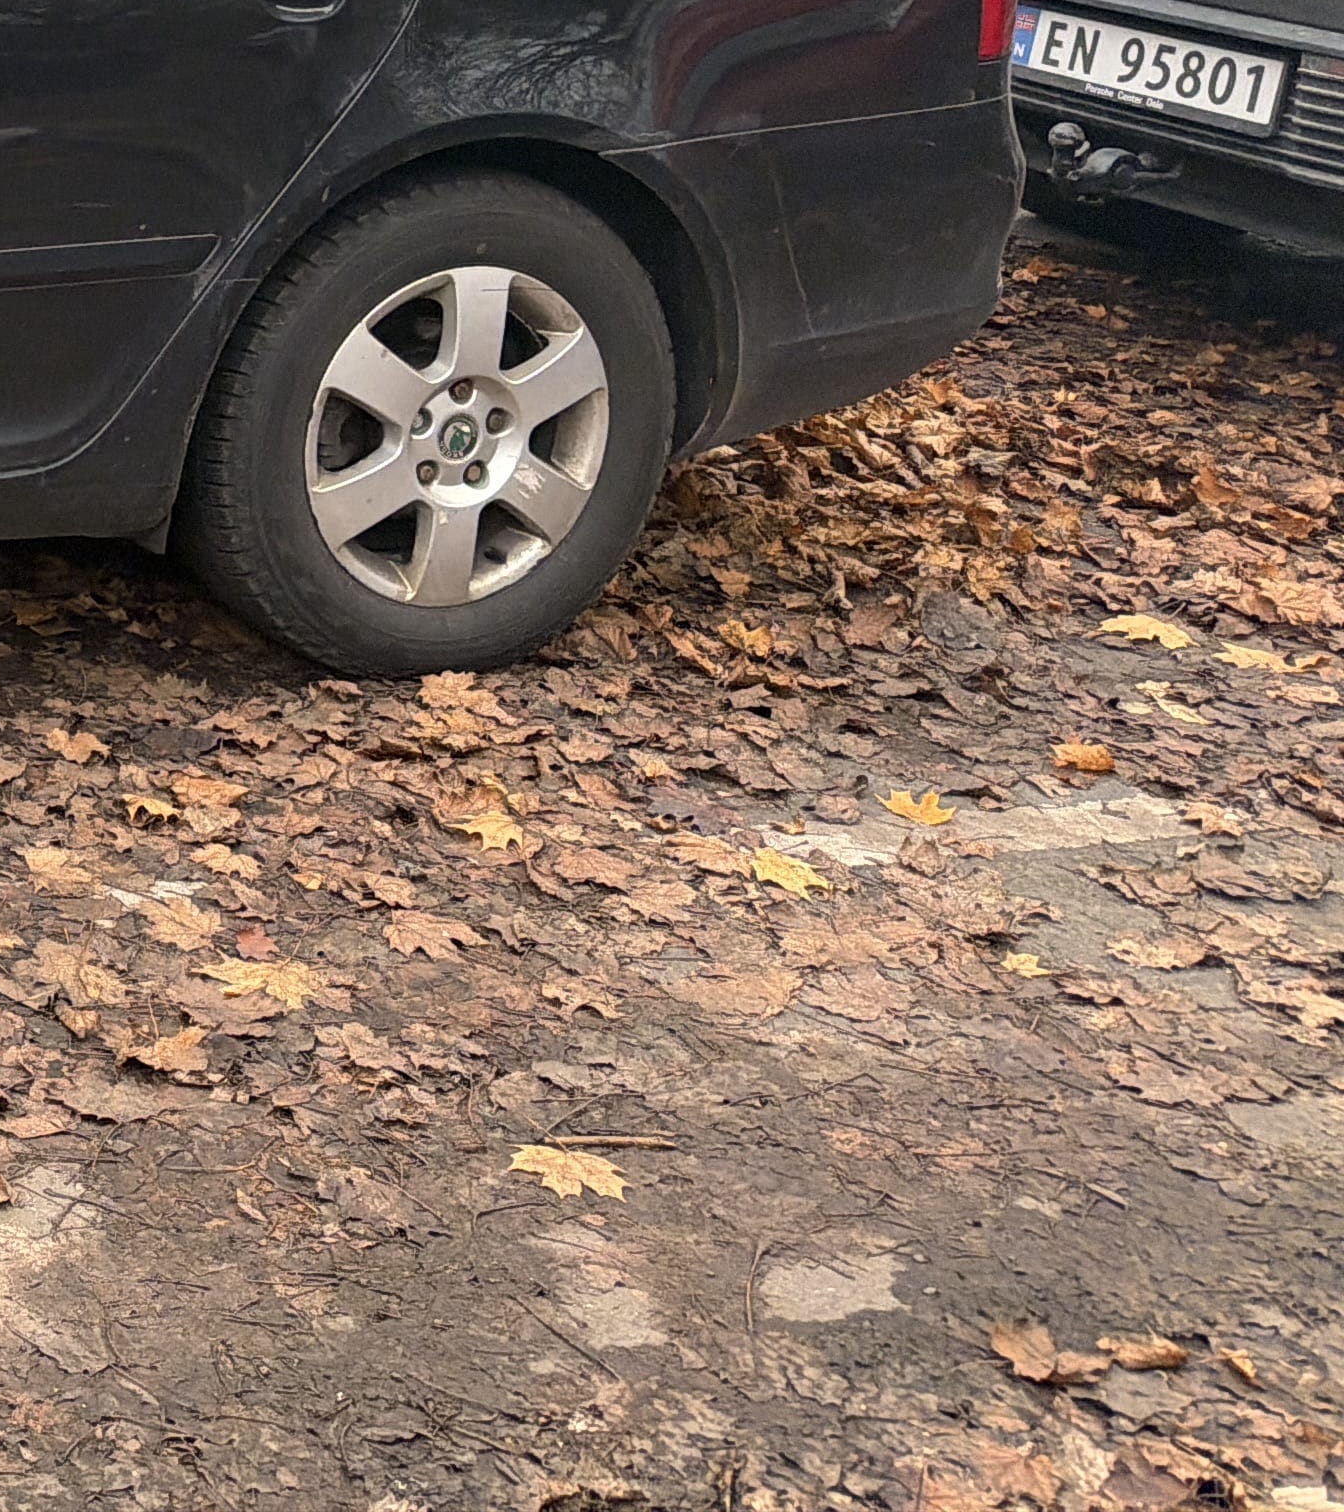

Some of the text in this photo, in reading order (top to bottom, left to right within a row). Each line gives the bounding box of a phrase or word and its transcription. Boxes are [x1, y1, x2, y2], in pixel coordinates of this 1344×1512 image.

[1041, 20, 1101, 75] EN
[1117, 37, 1266, 114] 95801
[1084, 82, 1115, 98] Porsche
